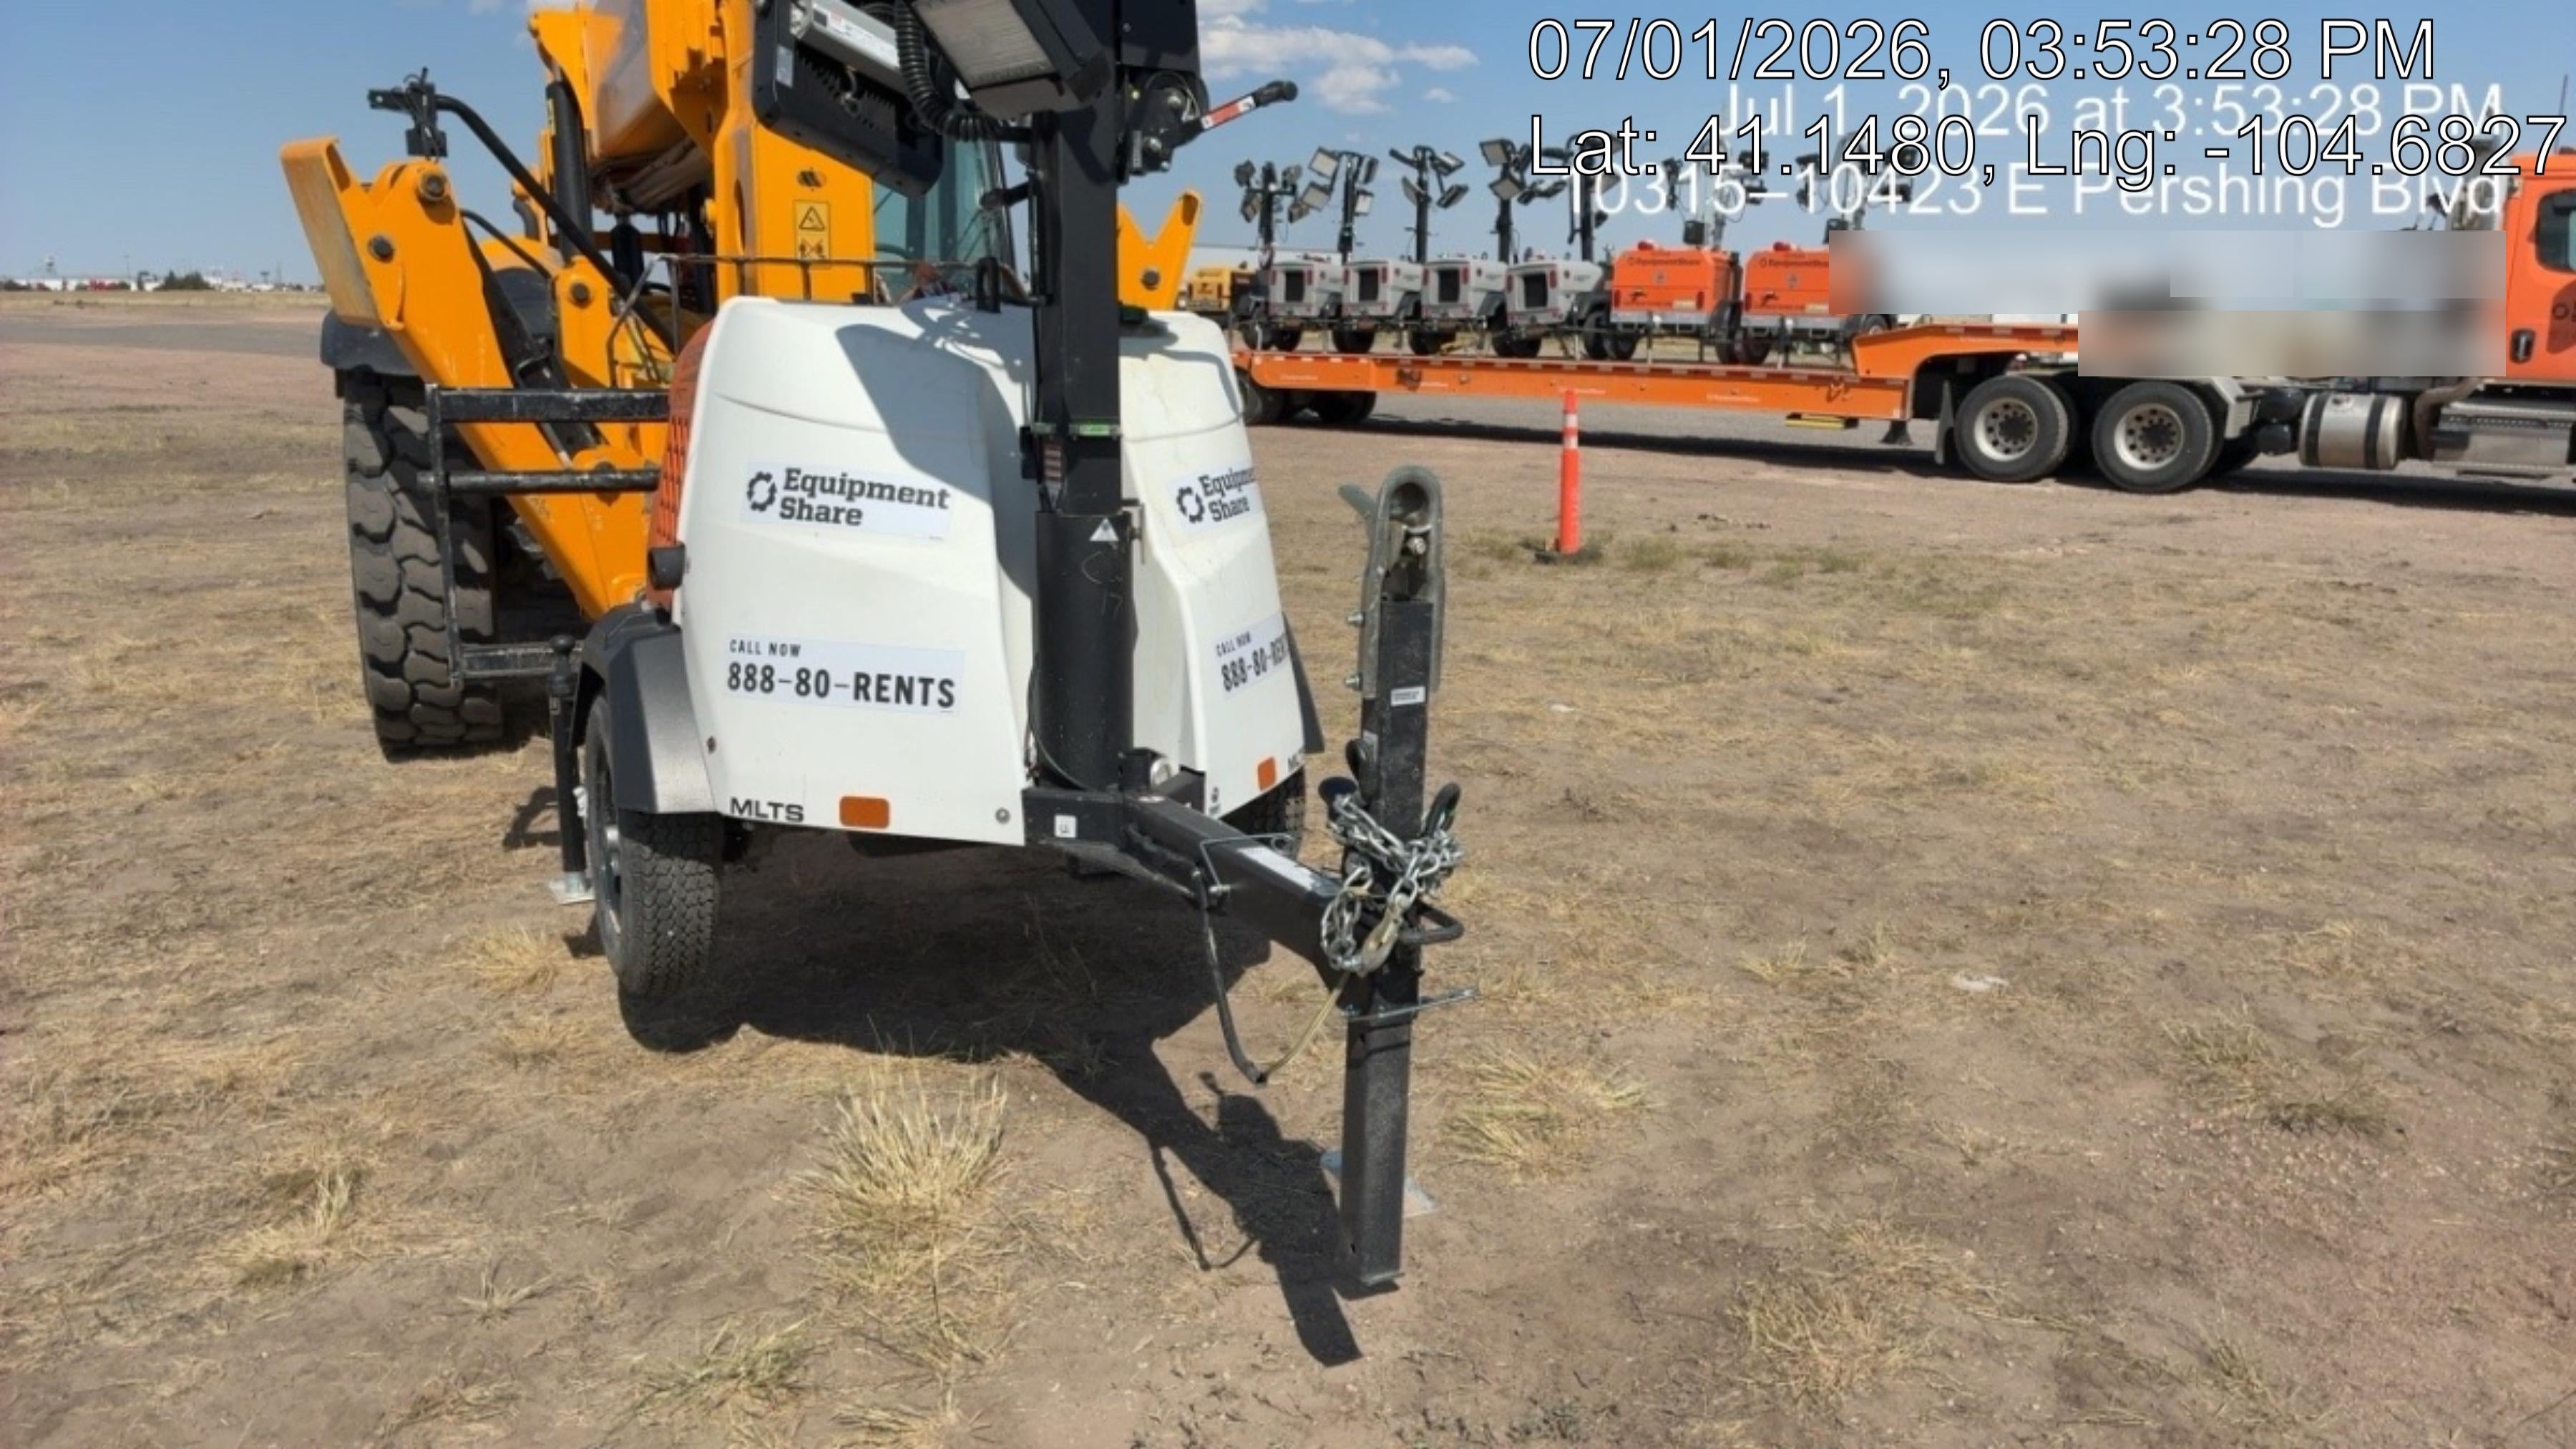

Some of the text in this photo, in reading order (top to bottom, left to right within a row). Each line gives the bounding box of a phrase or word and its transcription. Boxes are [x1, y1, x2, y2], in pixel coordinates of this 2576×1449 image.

[783, 467, 951, 509] Equipment
[779, 496, 863, 526] Share
[1208, 496, 1250, 522] Share
[729, 639, 801, 658] CALL NOW
[727, 661, 956, 708] 888-80-RENTS
[730, 796, 804, 822] MLTS
